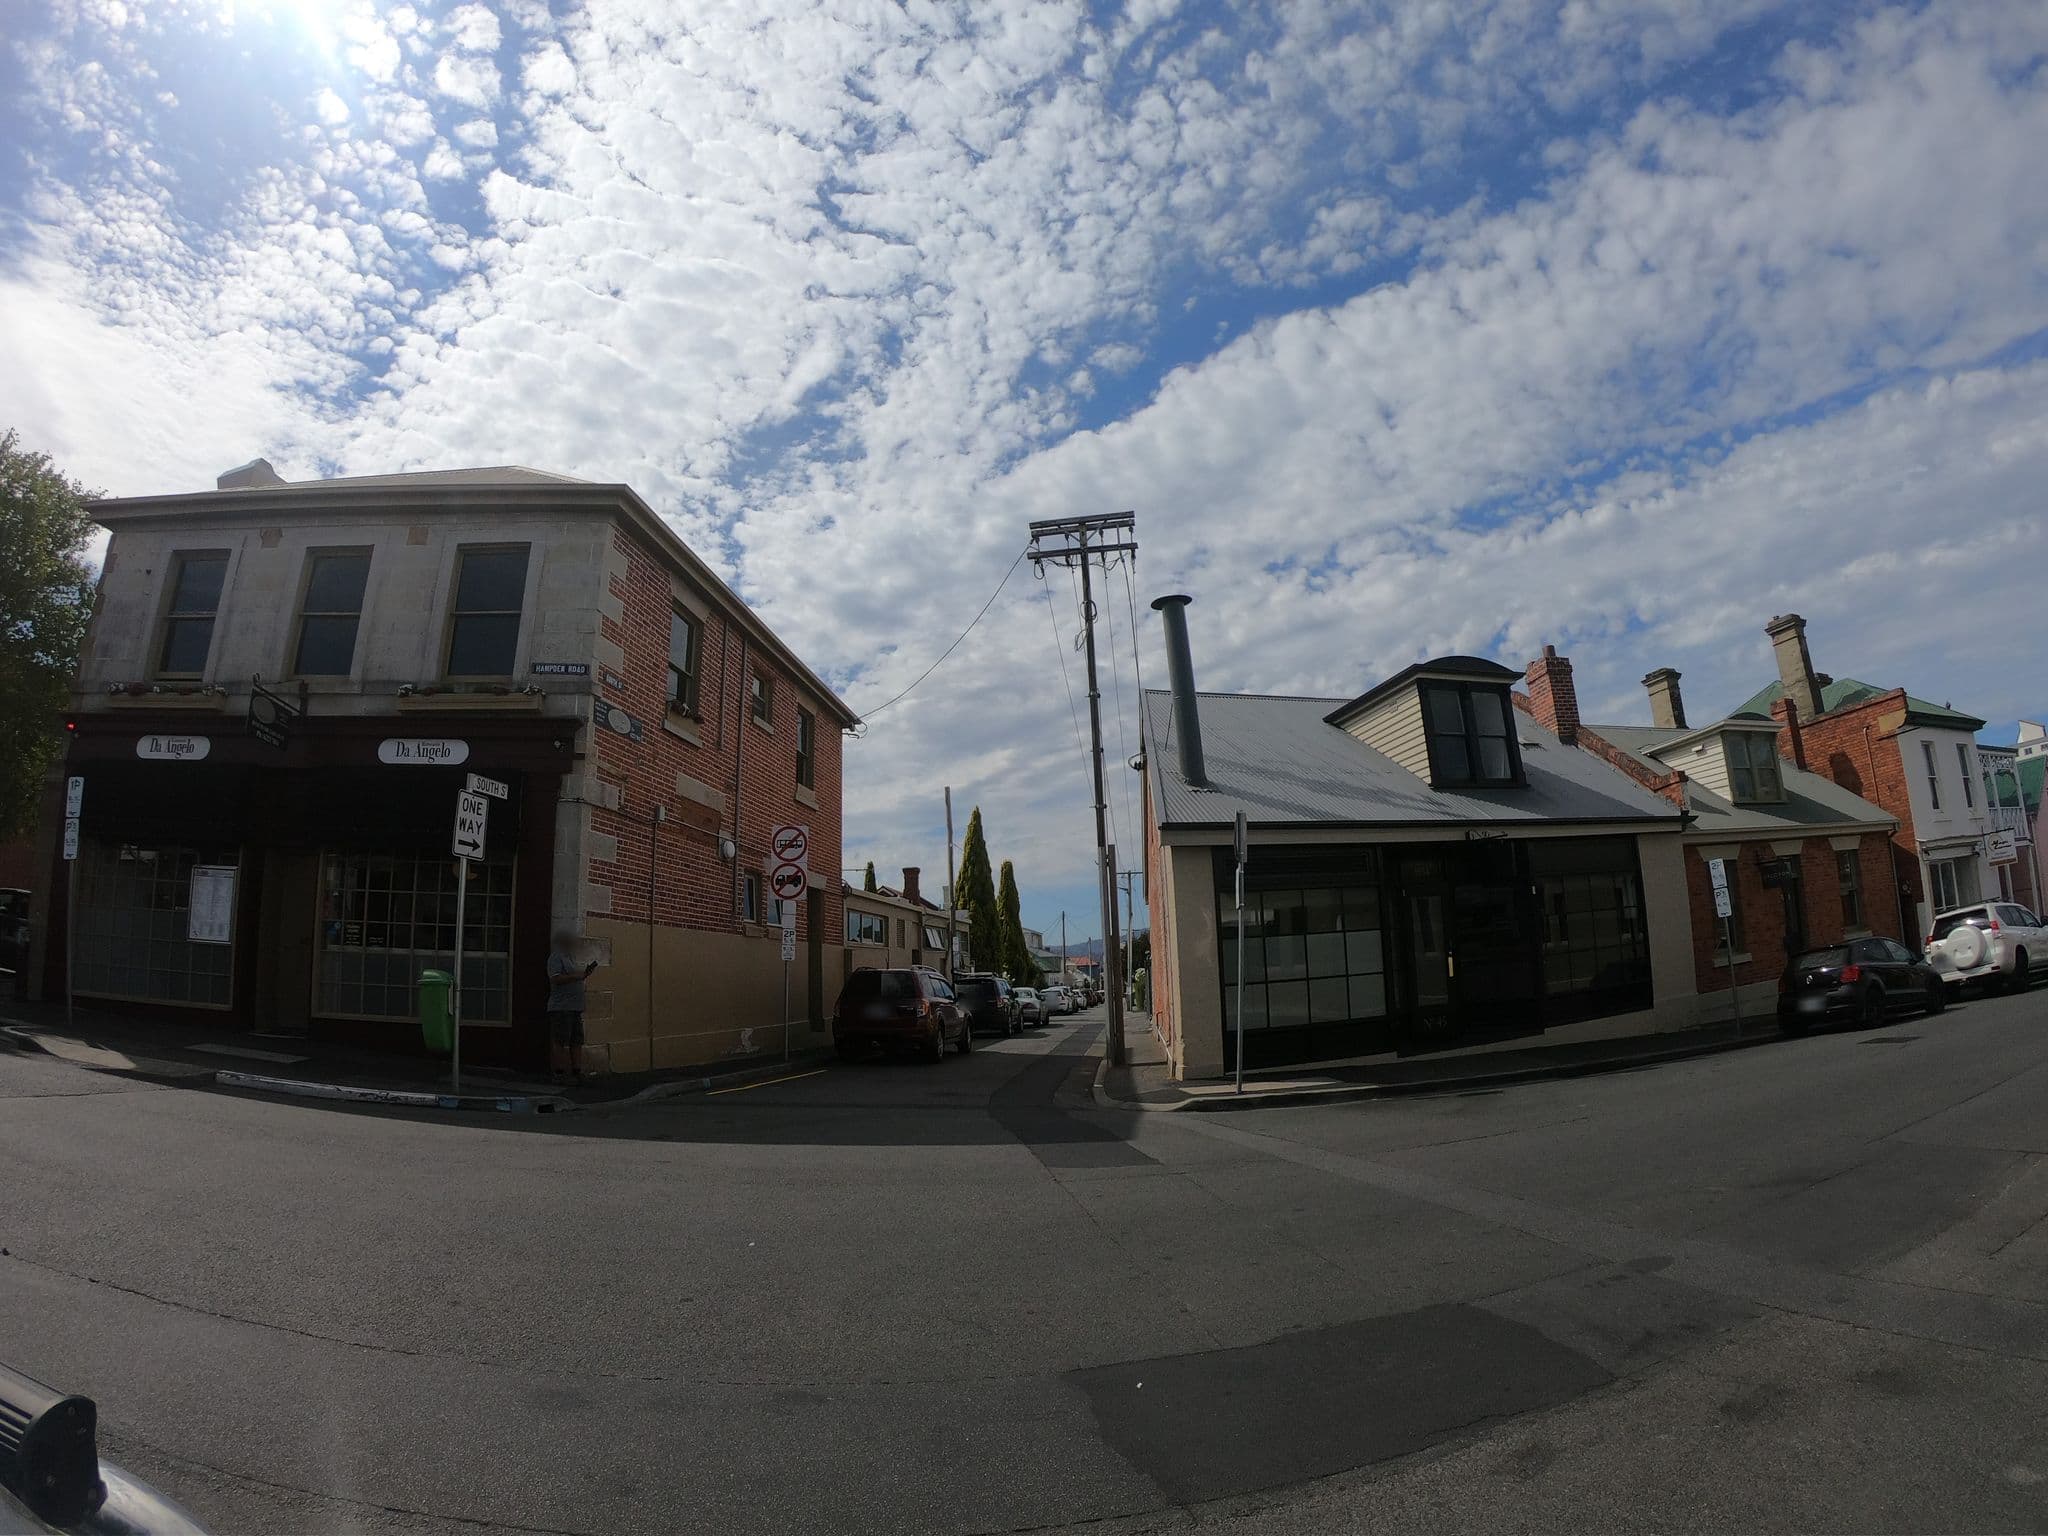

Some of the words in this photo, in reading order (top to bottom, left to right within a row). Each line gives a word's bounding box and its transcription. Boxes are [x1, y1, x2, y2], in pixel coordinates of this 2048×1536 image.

[535, 664, 566, 673] HAMPDEN
[568, 664, 586, 673] ROAD
[149, 737, 162, 753] Da
[165, 738, 195, 759] Angelo
[396, 741, 410, 757] Da
[413, 741, 451, 763] Angelo
[476, 777, 500, 794] SOUTH
[462, 798, 483, 816] ONE
[459, 817, 484, 835] WAY
[784, 930, 795, 938] 2P
